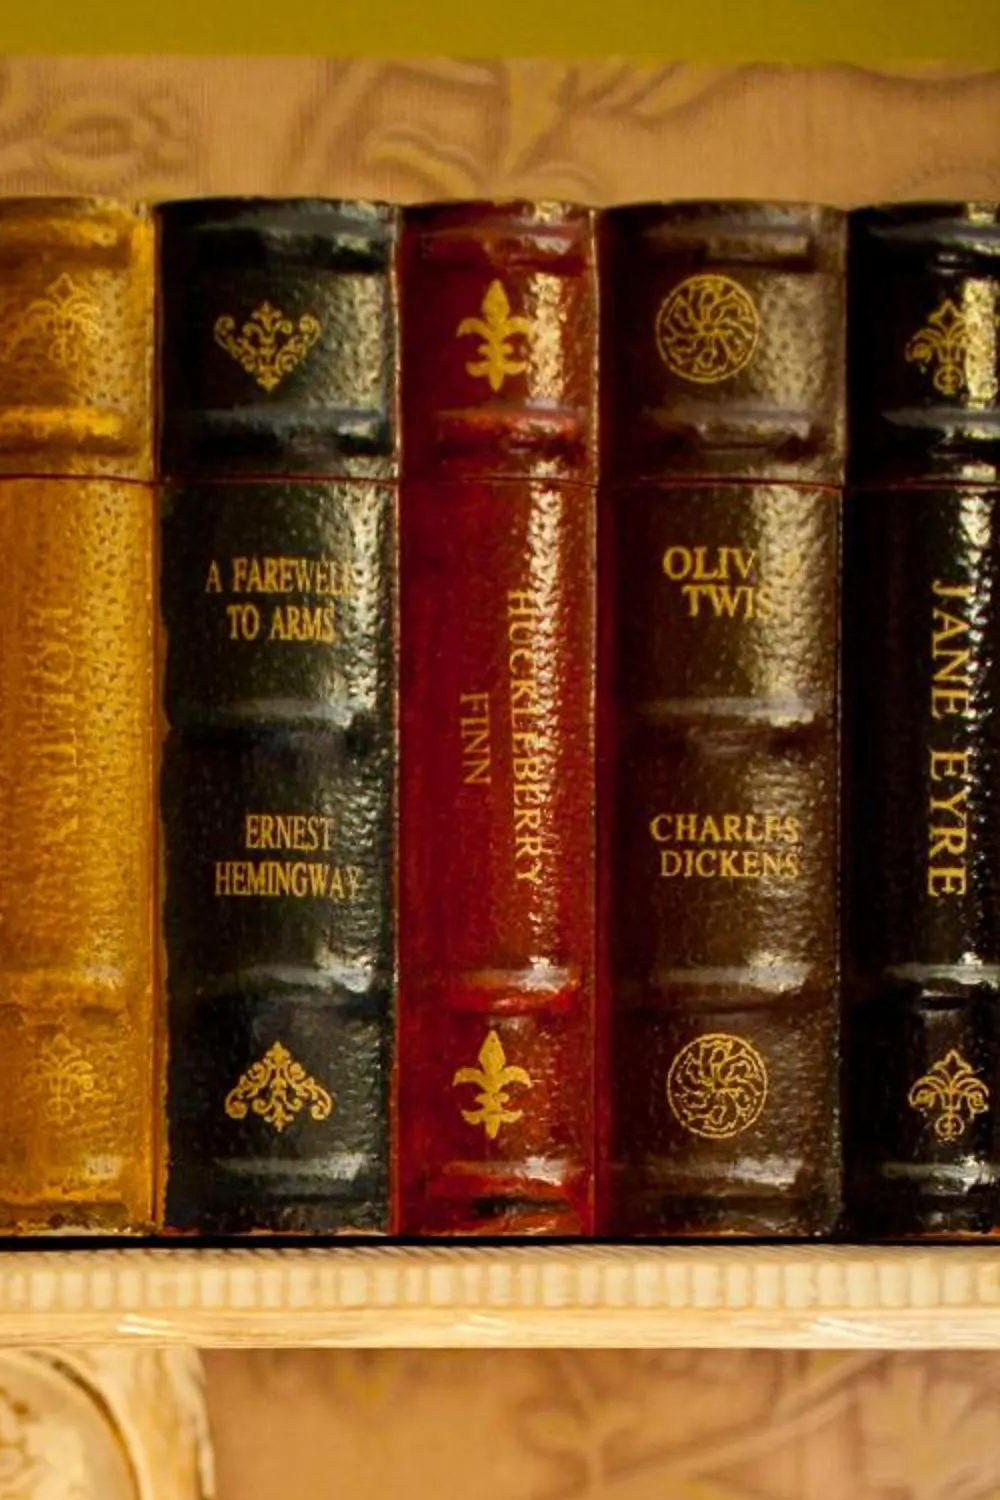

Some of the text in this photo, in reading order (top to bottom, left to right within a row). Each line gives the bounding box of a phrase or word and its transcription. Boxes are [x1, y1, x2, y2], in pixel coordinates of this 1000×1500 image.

[205, 558, 223, 593] A
[662, 545, 802, 582] OLIV
[226, 603, 337, 645] TO ARMS
[459, 691, 492, 785] FINN
[927, 580, 972, 898] JANE EYRE
[245, 813, 336, 851] ERNEST
[650, 813, 801, 843] CHARLES
[214, 861, 364, 899] HEMINGWAY
[660, 849, 801, 882] DICKENS
